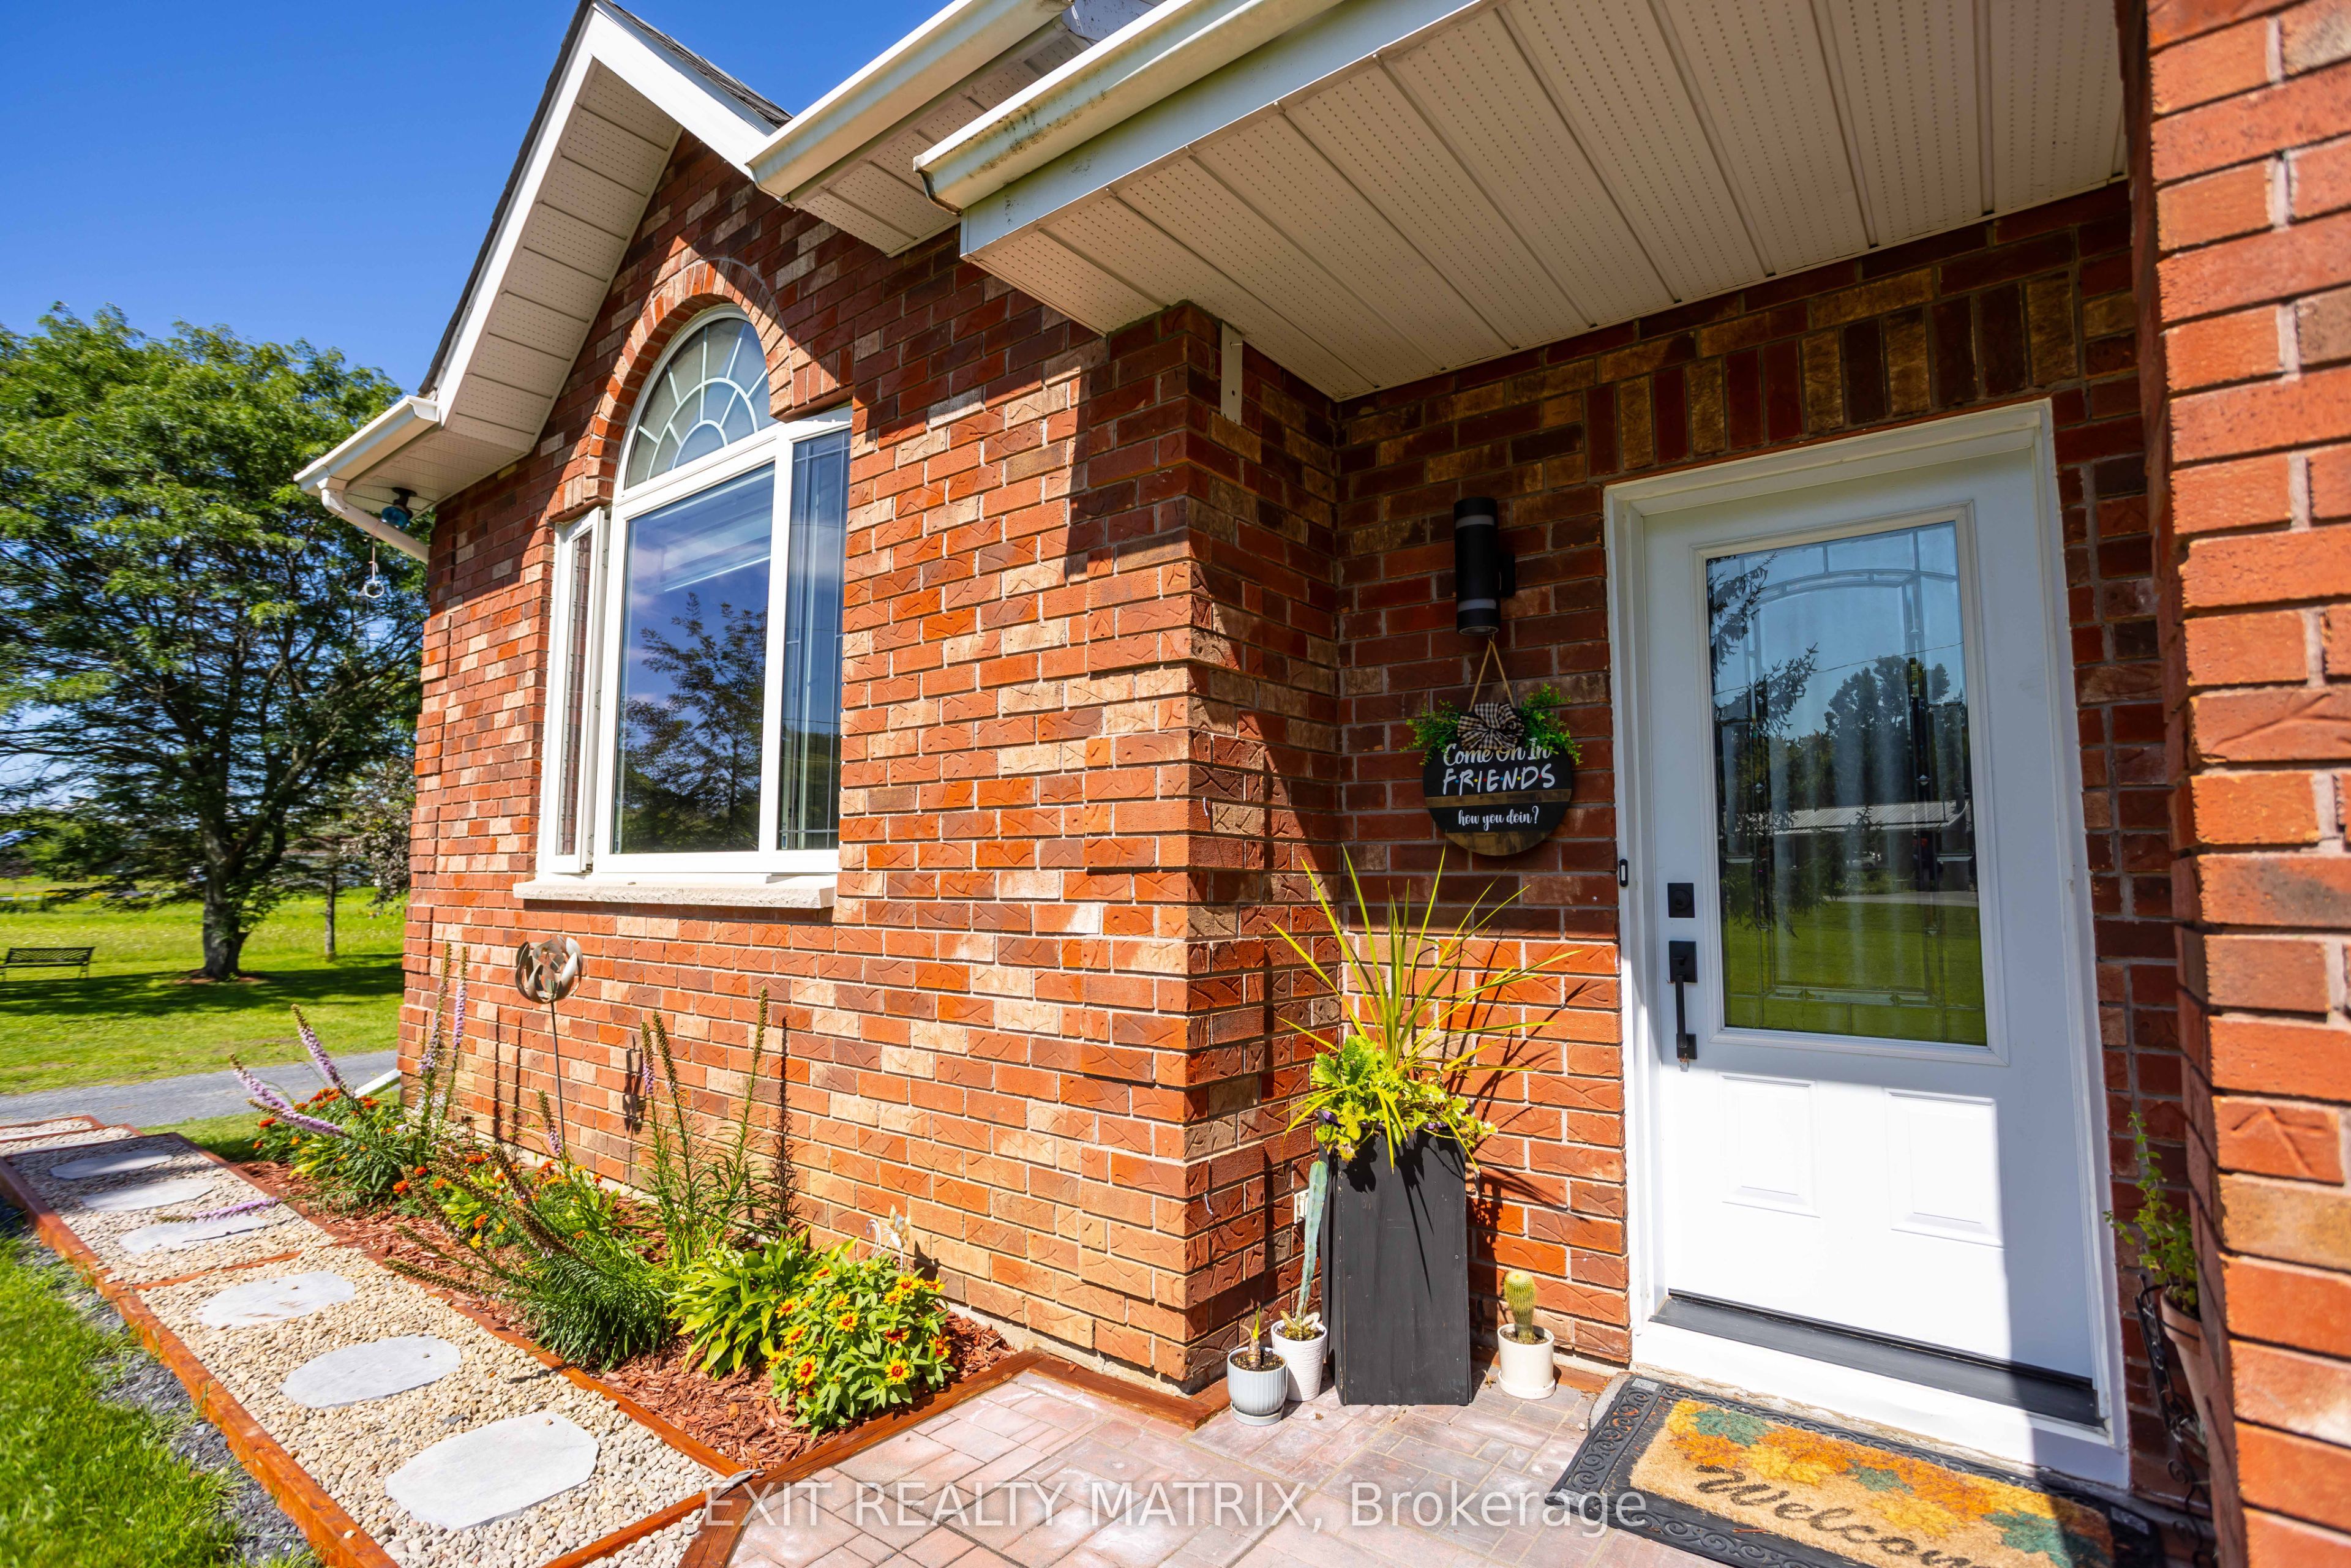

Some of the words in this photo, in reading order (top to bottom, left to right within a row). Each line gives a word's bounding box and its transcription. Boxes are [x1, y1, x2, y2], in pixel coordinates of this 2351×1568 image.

[1443, 743, 1494, 766] Come
[1442, 763, 1555, 796] FRIENDS
[1458, 809, 1479, 826] how
[1482, 814, 1504, 831] you
[1506, 806, 1539, 824] doin?
